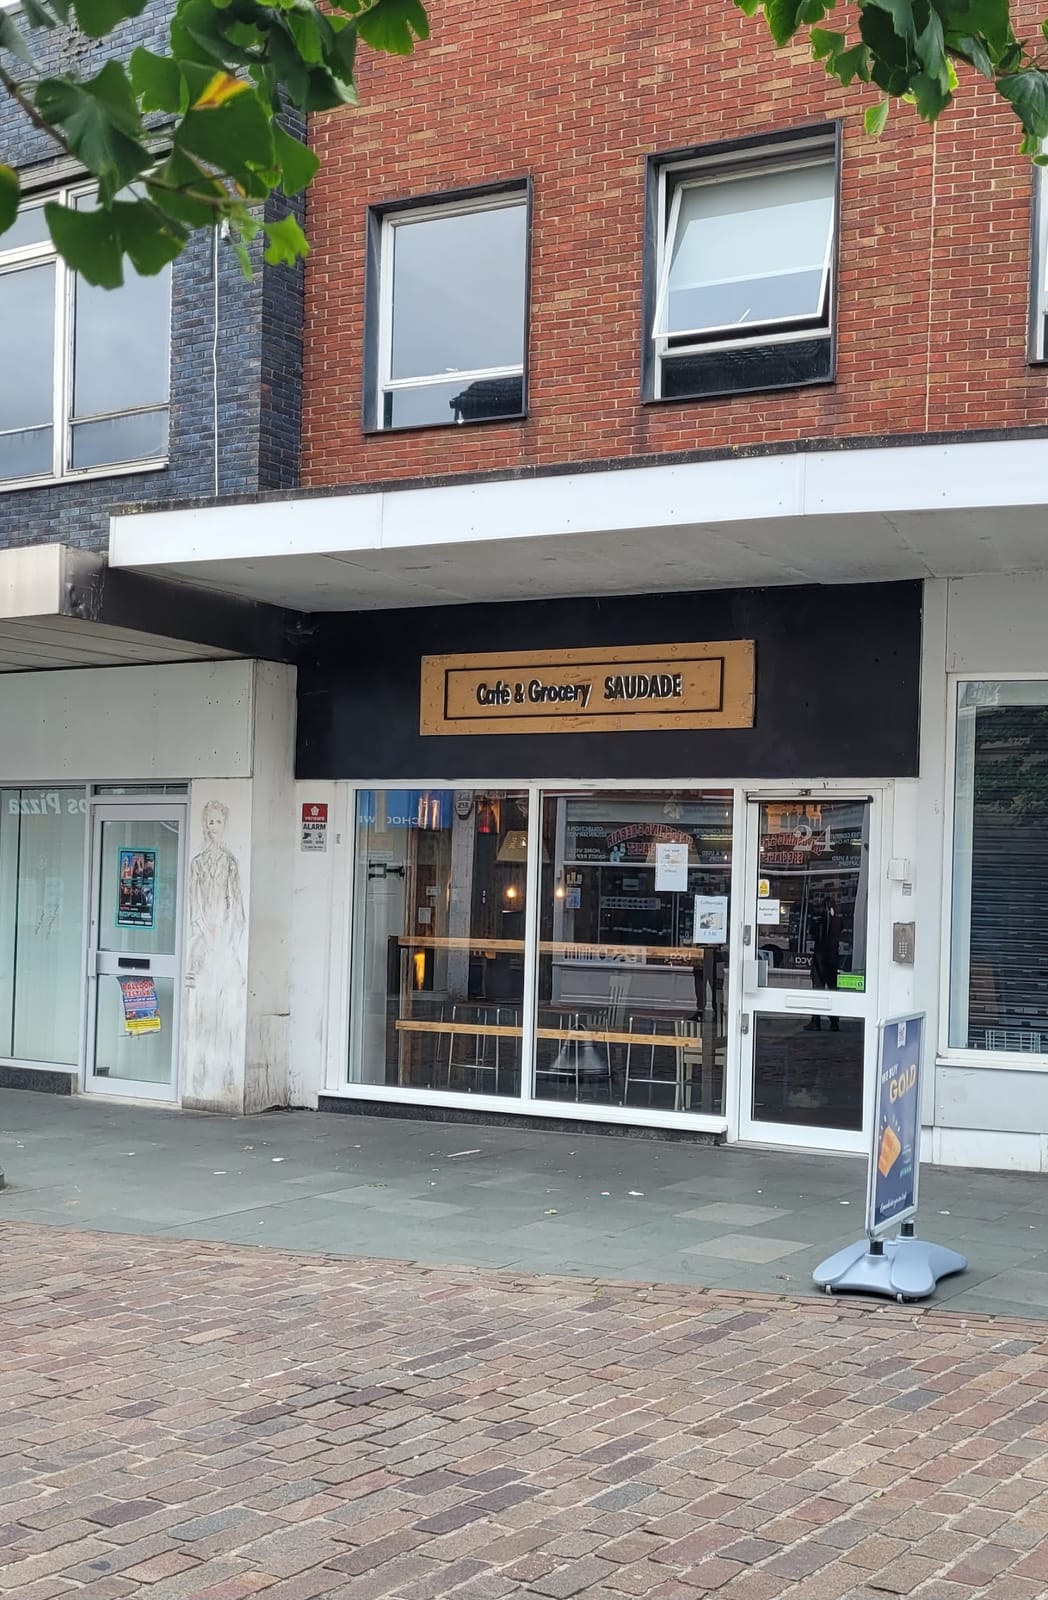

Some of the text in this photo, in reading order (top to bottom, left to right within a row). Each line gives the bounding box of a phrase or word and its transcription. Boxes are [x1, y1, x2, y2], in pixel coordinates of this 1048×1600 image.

[514, 683, 526, 704] &
[528, 679, 593, 709] Grocery
[603, 673, 683, 700] SAUDADE
[793, 824, 836, 852] 24
[890, 1063, 917, 1105] GOLD
